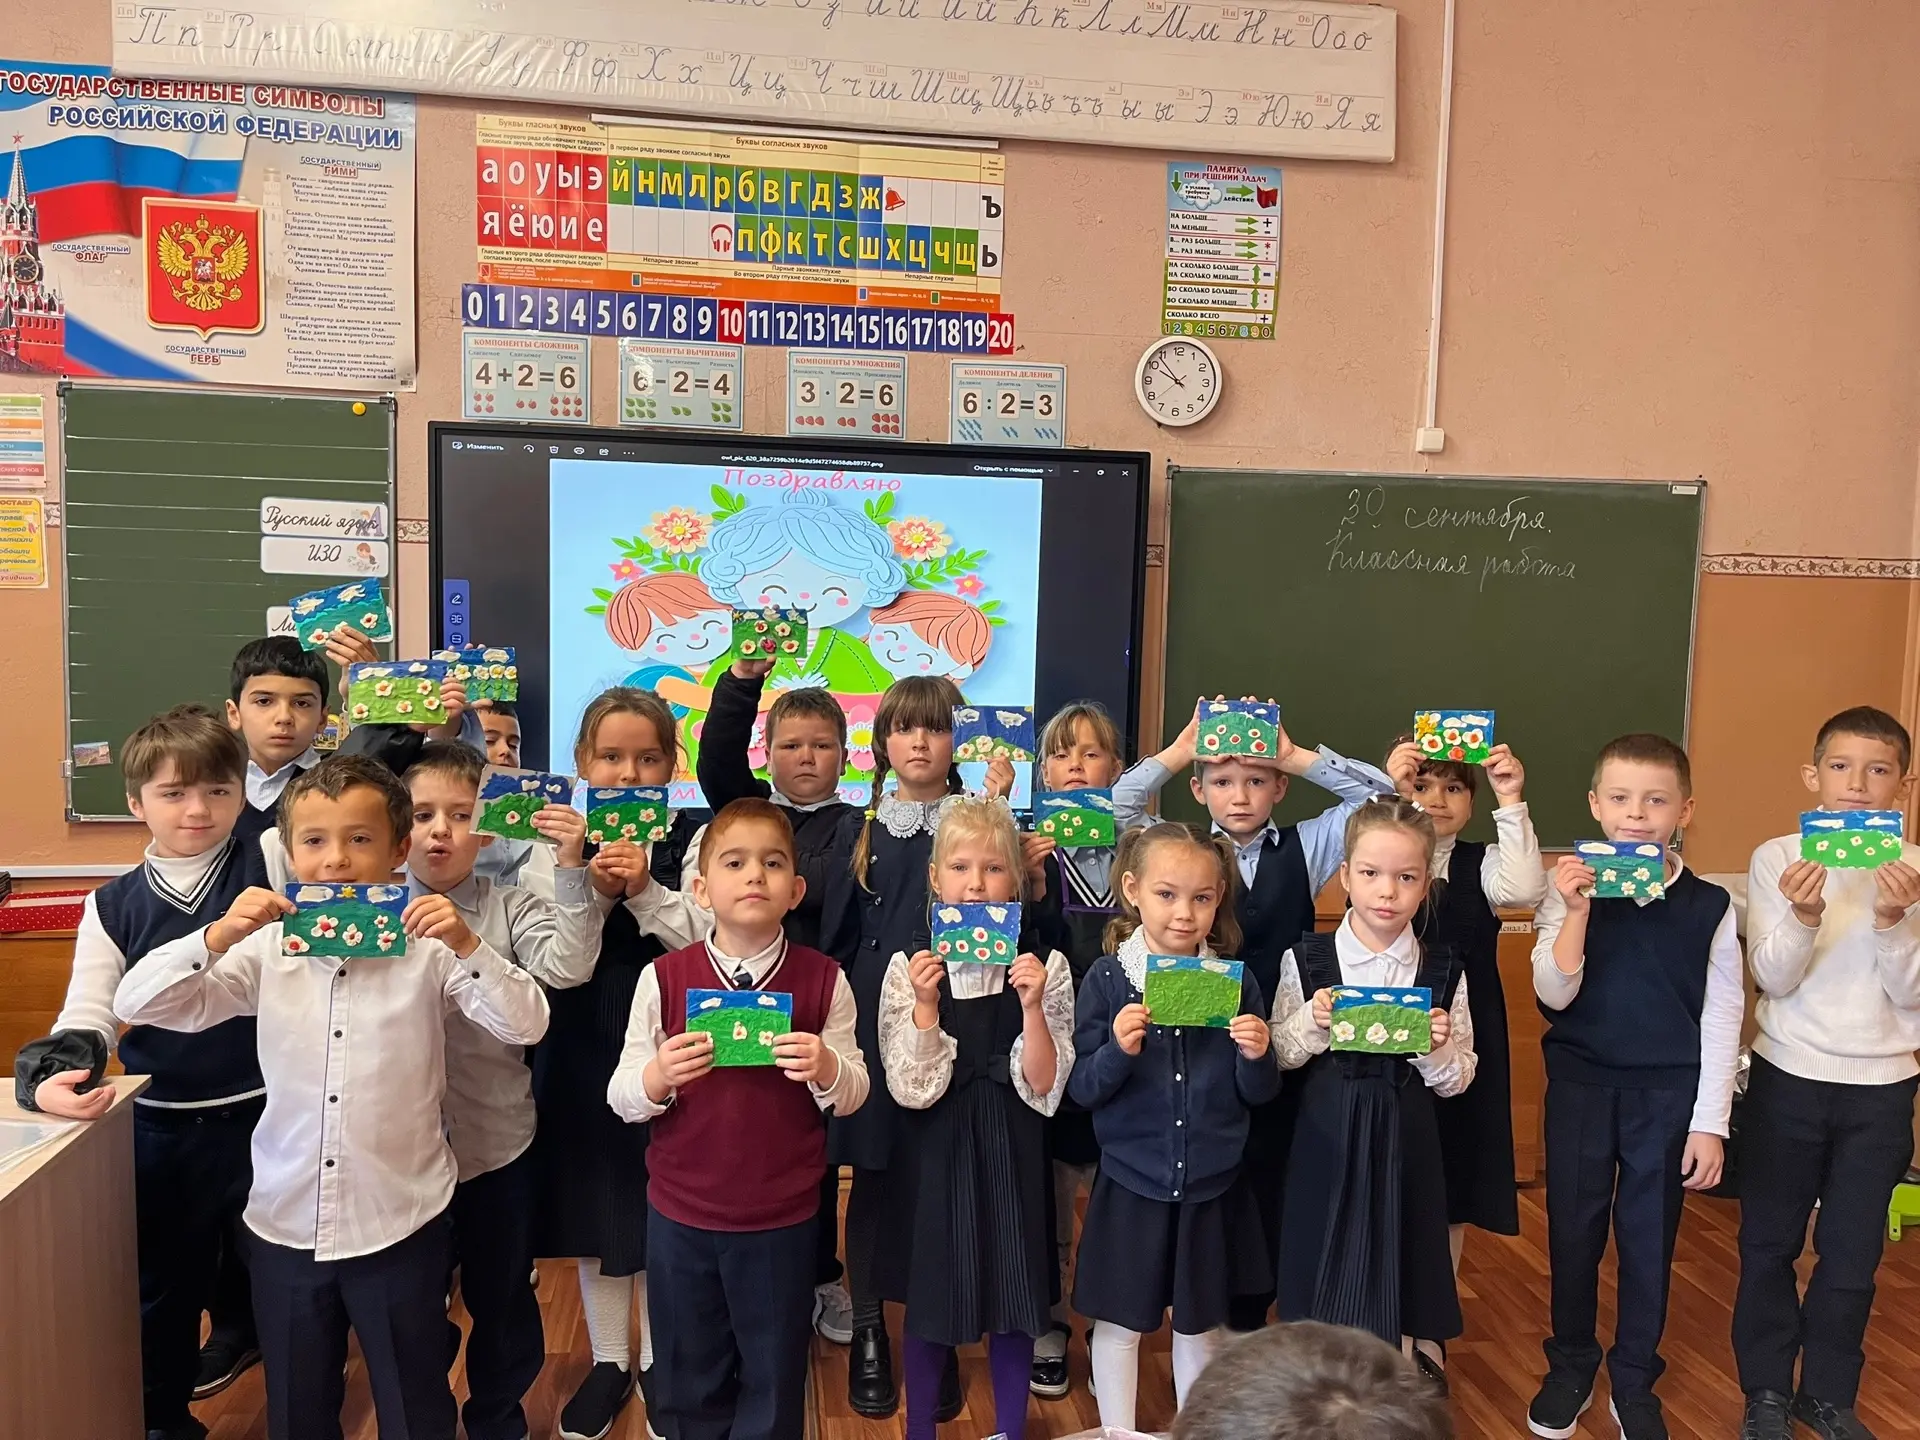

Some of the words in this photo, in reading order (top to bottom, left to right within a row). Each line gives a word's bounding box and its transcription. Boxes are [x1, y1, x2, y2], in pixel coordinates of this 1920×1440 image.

[0, 72, 246, 104] ГОСУДАРСТВЕННЫЕ
[253, 85, 385, 117] СИМВОЛЫ
[49, 105, 226, 132] РОССИЙСКОЙ
[235, 115, 401, 149] ФЕДЕРАЦИИ
[498, 119, 523, 127] Буквы
[526, 121, 558, 130] гласных
[736, 137, 760, 146] Буквы
[762, 139, 800, 148] согласных
[301, 156, 379, 168] ГОСУДАРСТВЕННЫЙ
[324, 166, 357, 176] ГИМН
[1207, 165, 1247, 174] ПАМЯТКА
[482, 158, 499, 183] а
[509, 160, 525, 185] о
[535, 162, 551, 195] у
[558, 164, 579, 188] ы
[588, 166, 603, 190] э
[1202, 173, 1238, 181] РЕШЕНИИ
[613, 160, 628, 192] й
[639, 170, 654, 194] н
[661, 172, 683, 196] м
[689, 174, 706, 197] л
[714, 176, 730, 208] р
[738, 171, 755, 202] б
[763, 180, 779, 203] в
[790, 182, 802, 204] г
[812, 183, 831, 212] д
[839, 185, 853, 208] з
[860, 187, 880, 209] ж
[52, 244, 129, 252] ГОСУДАРСТВЕННЫЙ
[76, 253, 105, 261] ФЛАГ
[643, 257, 673, 265] Непарные
[468, 292, 483, 321] 0
[495, 293, 505, 322] 1
[520, 295, 533, 324] 2
[545, 296, 559, 325] 3
[571, 299, 586, 327] 4
[597, 300, 610, 328] 5
[622, 301, 636, 330] 6
[648, 303, 662, 332] 7
[672, 304, 686, 334] 8
[698, 306, 712, 335] 9
[720, 308, 743, 337] 10
[748, 309, 769, 338] 11
[776, 310, 798, 340] 12
[804, 312, 826, 342] 13
[831, 312, 854, 342] 14
[858, 314, 880, 344] 15
[885, 316, 907, 346] 16
[912, 317, 933, 346] 17
[938, 318, 960, 346] 18
[964, 320, 986, 346] 19
[989, 320, 1012, 348] 20
[474, 339, 531, 348] КОМПОНЕНТЫ
[534, 341, 579, 350] СЛОЖЕНИЯ
[165, 346, 244, 355] ГОСУДАРСТВЕННЫЙ
[687, 349, 736, 357] ВЫЧИТАНИЯ
[1159, 351, 1166, 359] 11
[1173, 347, 1185, 356] 12
[191, 355, 219, 363] ГЕРБ
[795, 358, 850, 366] КОМПОНЕНТЫ
[852, 360, 900, 368] УМНОЖЕНИЯ
[1148, 361, 1159, 369] 10
[1199, 363, 1206, 372] 2
[964, 369, 1017, 377] КОМПОНЕНТЫ
[1145, 376, 1152, 385] 9
[1202, 379, 1210, 387] 3
[724, 469, 901, 493] Поздравляю
[263, 506, 332, 531] Русский
[336, 515, 379, 535] язык
[308, 544, 342, 562] ИЗО
[1325, 529, 1470, 575] Классная
[1479, 547, 1576, 592] работа
[1501, 924, 1520, 932] енал
